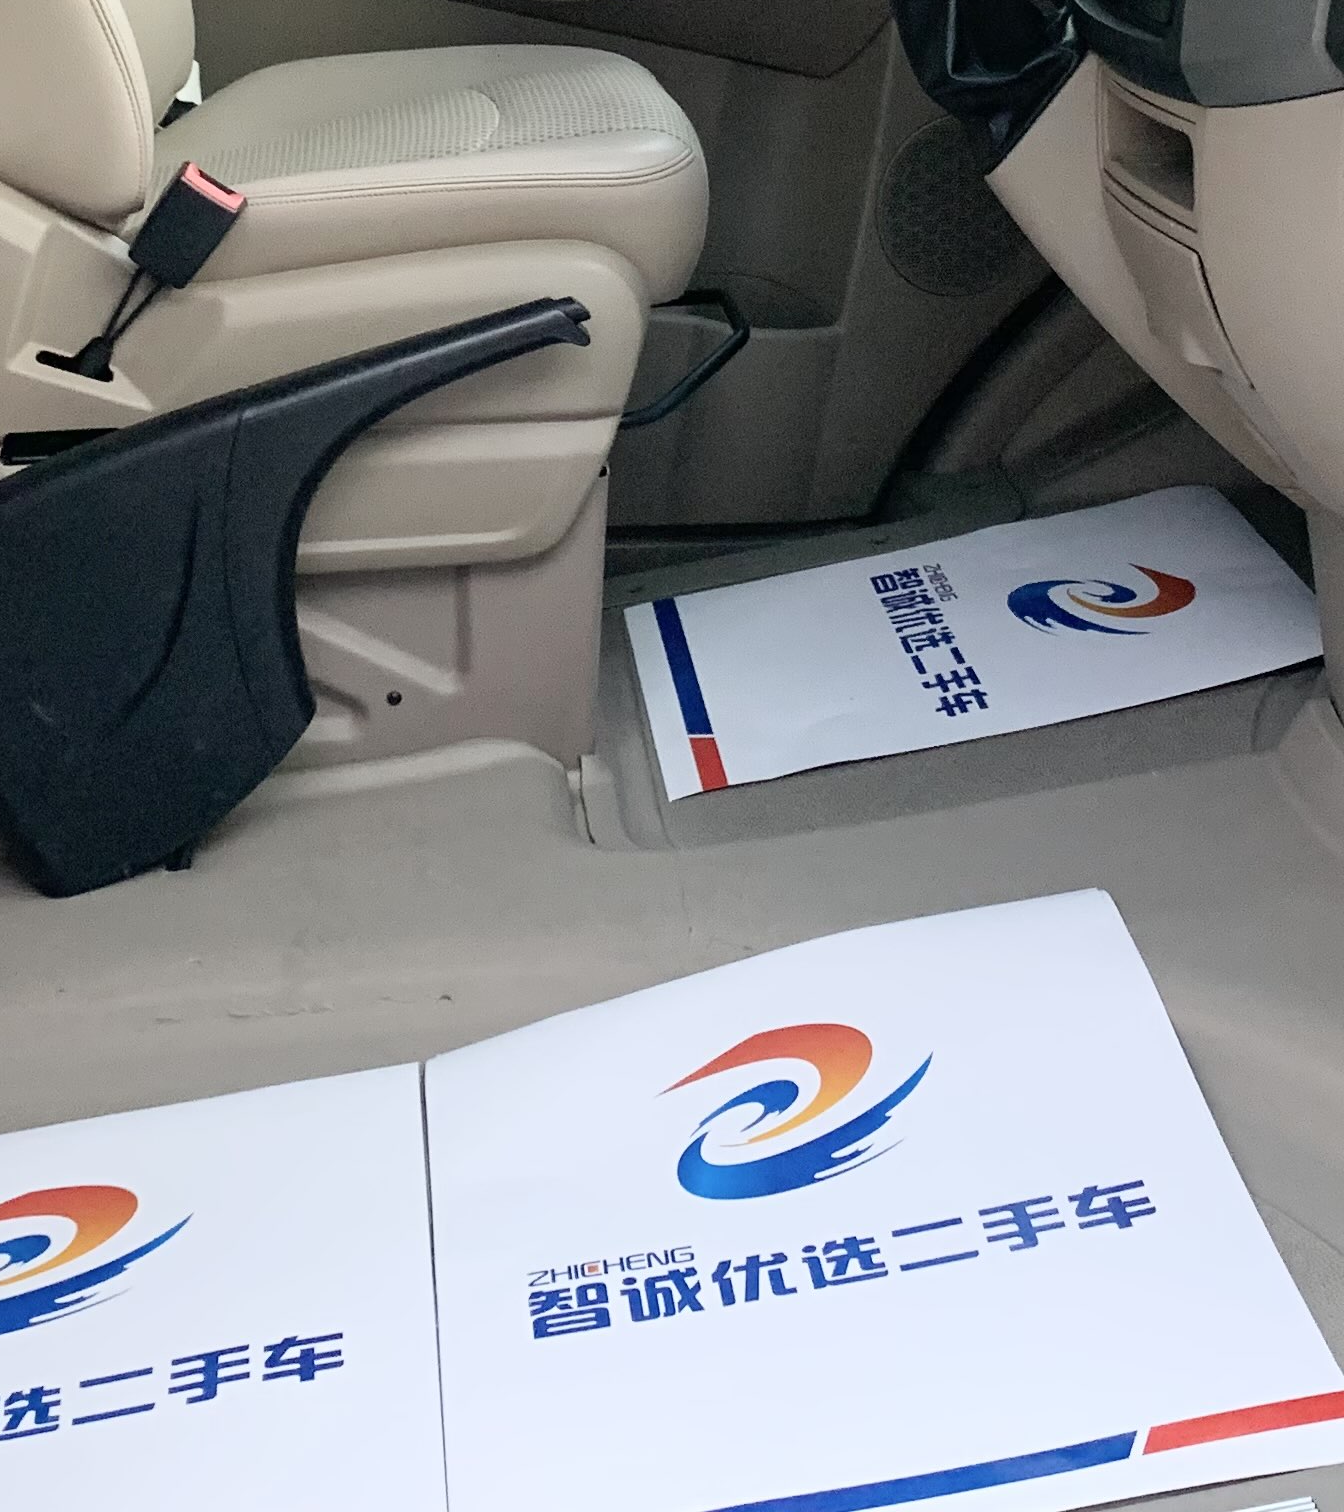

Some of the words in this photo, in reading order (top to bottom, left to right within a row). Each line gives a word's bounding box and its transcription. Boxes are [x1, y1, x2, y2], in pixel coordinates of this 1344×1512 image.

[870, 567, 989, 717] 智诚优选二手车
[527, 1246, 695, 1287] ZHICHENG
[528, 1179, 1157, 1340] 智诚优选二手车
